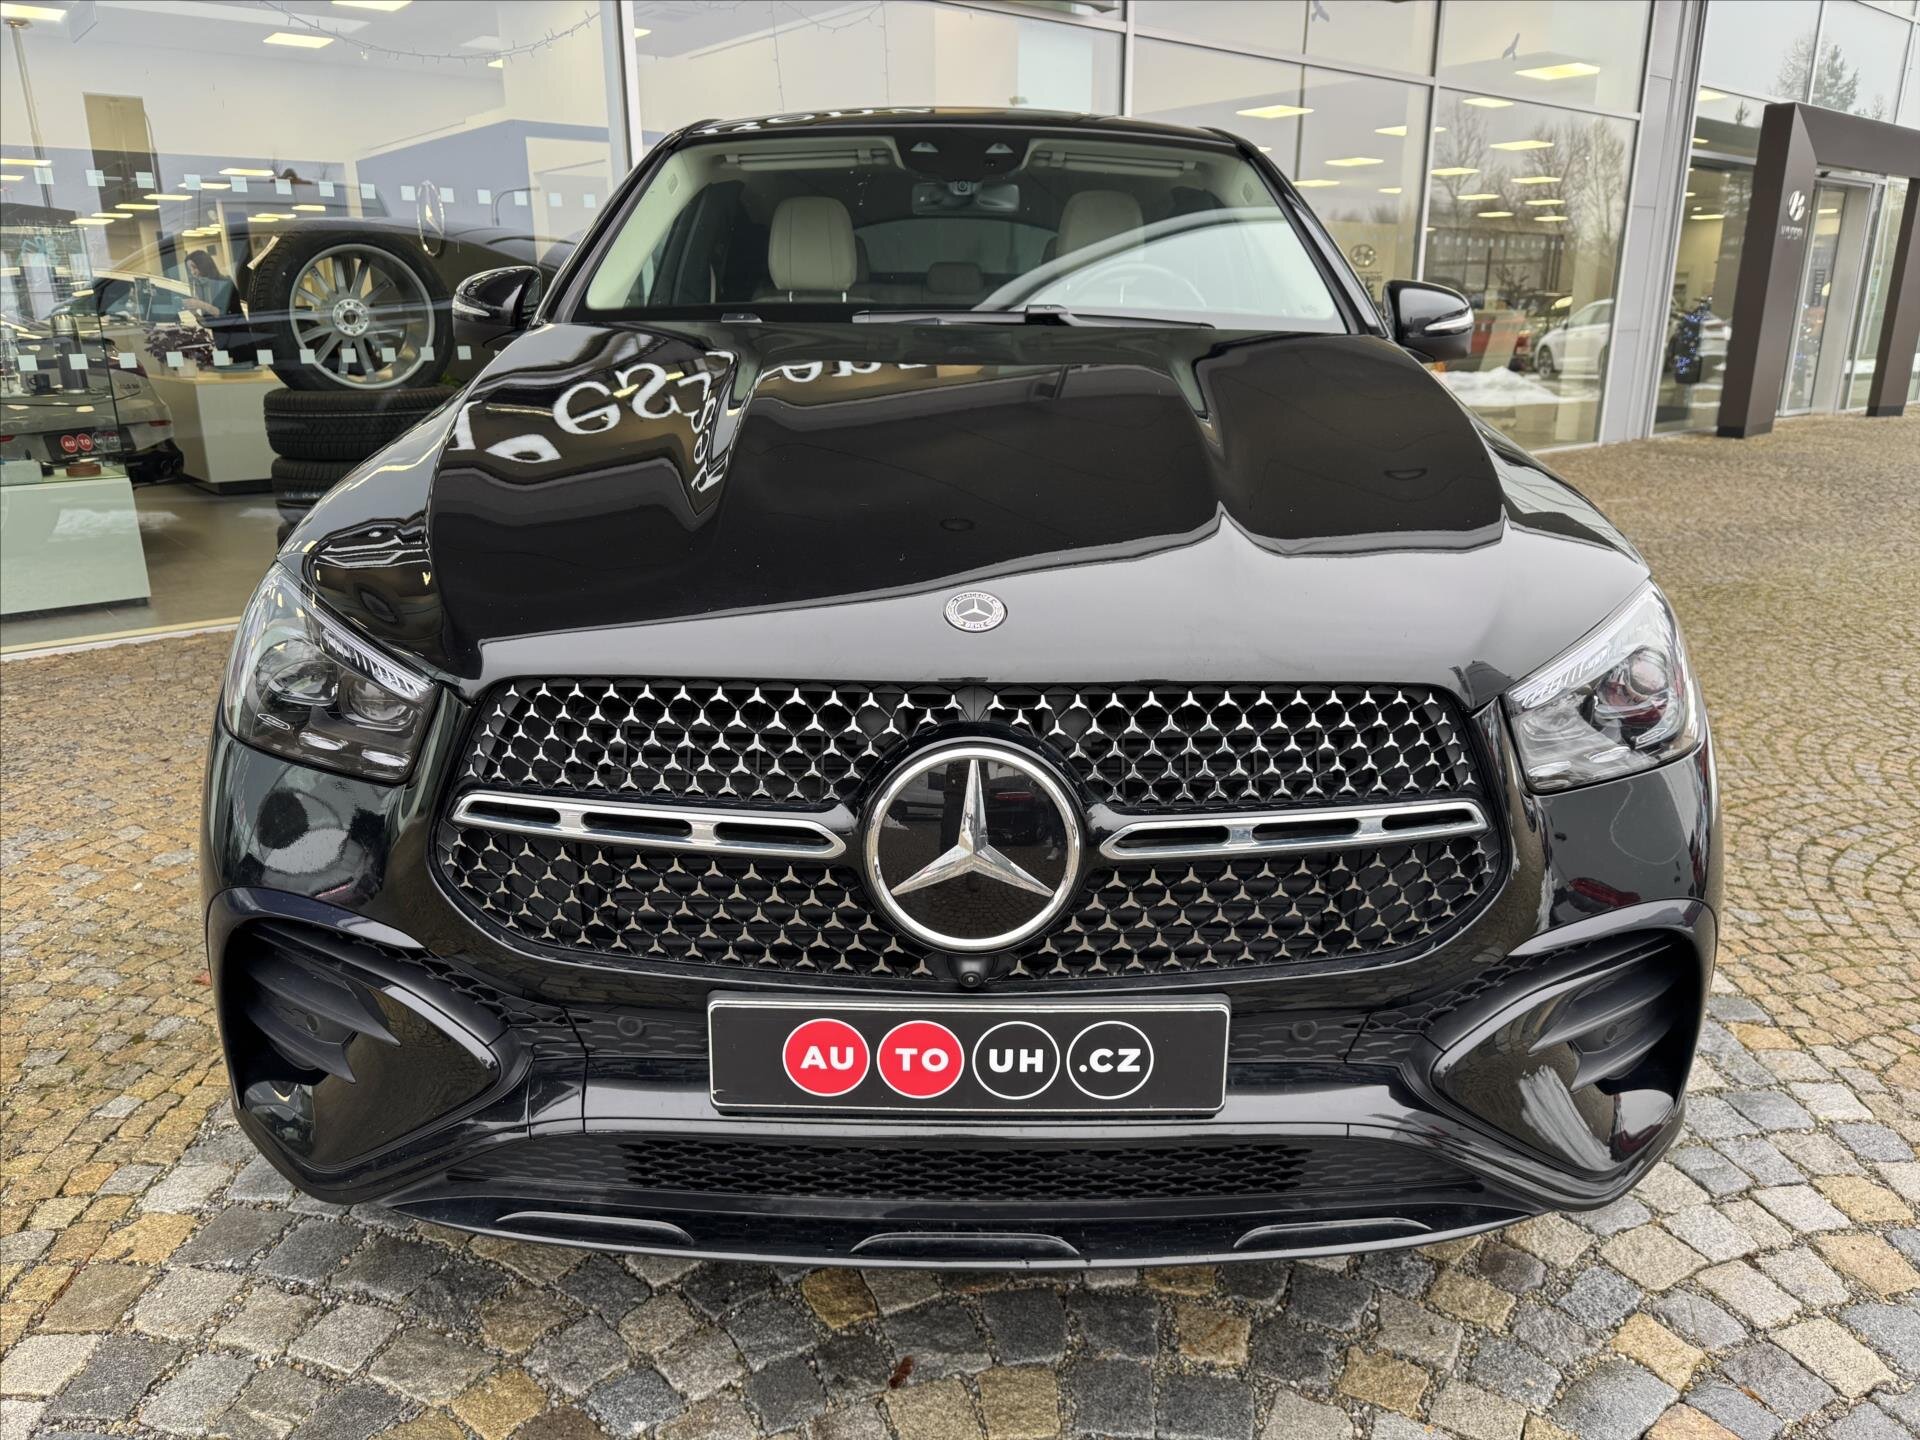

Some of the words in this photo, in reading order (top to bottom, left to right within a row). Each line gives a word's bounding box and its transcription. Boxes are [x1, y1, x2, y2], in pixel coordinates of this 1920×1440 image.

[800, 1045, 854, 1070] AU
[895, 1047, 950, 1071] TO
[988, 1048, 1044, 1073] UH
[1078, 1048, 1141, 1073] .CZ
